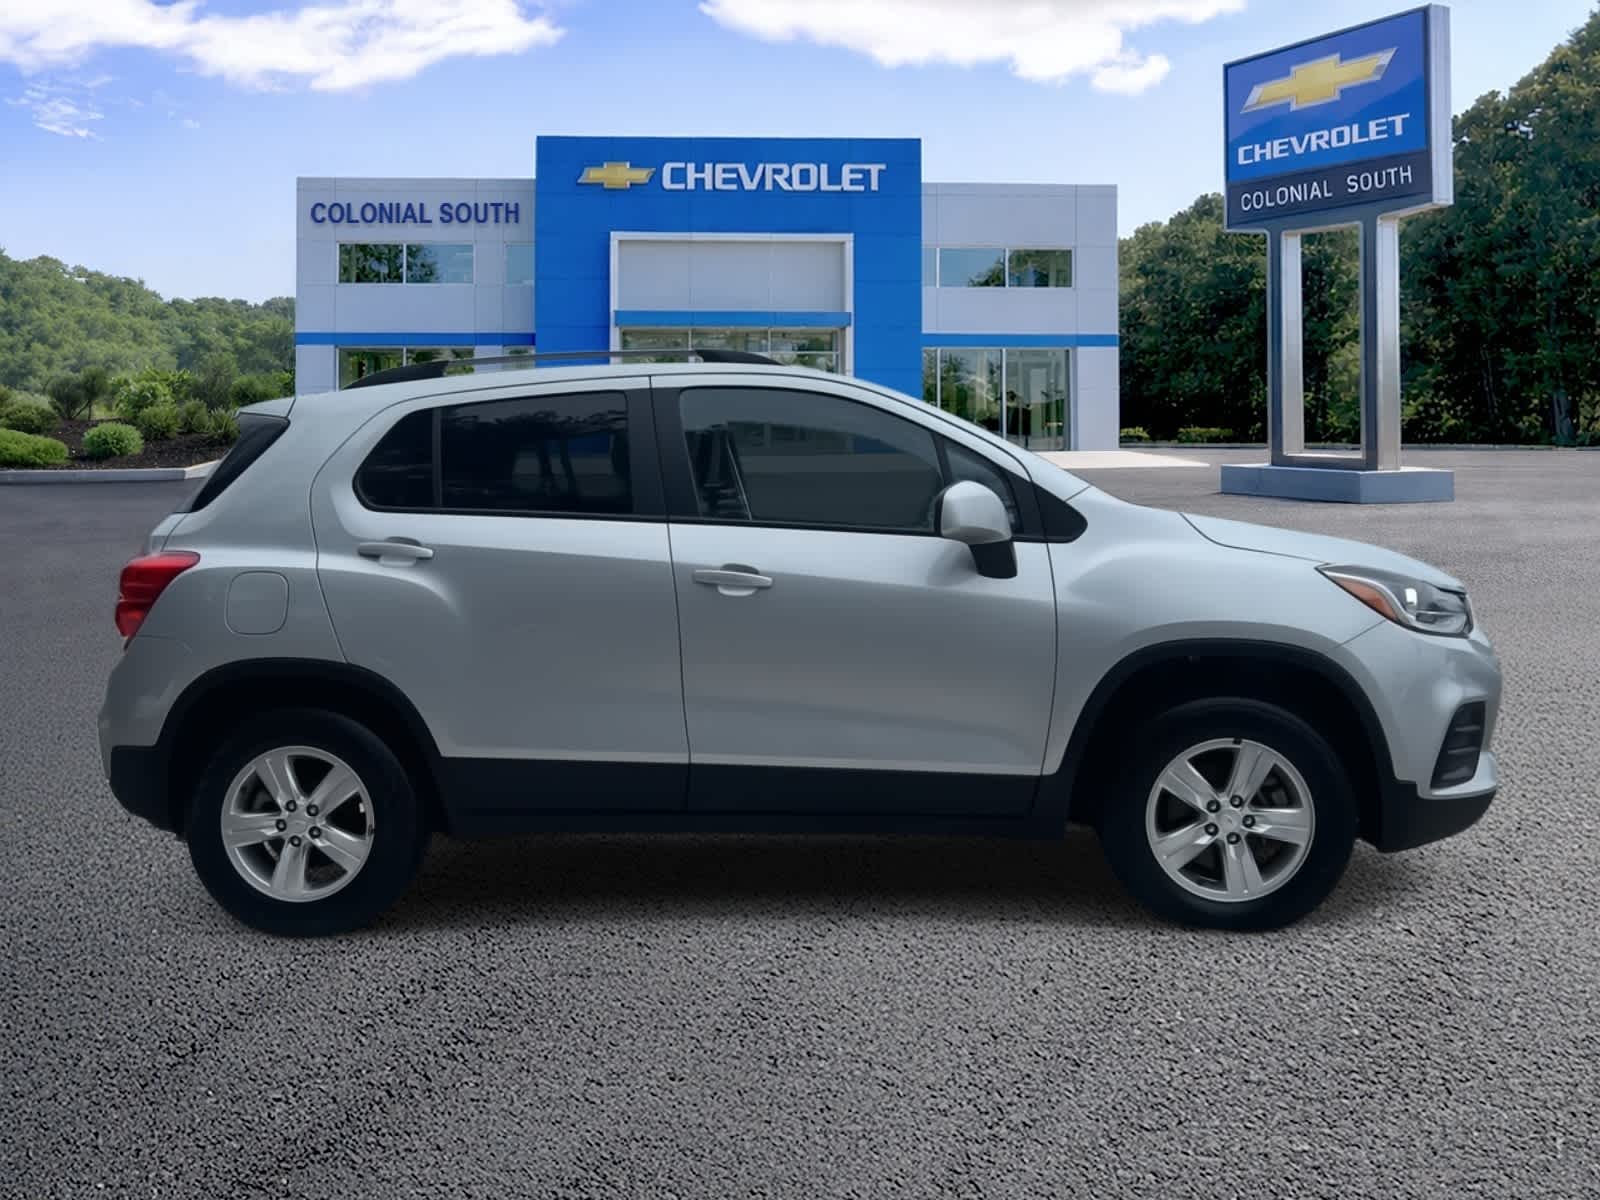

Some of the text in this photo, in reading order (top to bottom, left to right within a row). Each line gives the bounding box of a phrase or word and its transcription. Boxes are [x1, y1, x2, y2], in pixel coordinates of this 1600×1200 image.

[1237, 113, 1410, 165] CHEVROLET
[662, 161, 887, 191] CHEVROLET
[1241, 165, 1412, 211] COLONIAL SOUTH
[310, 202, 520, 225] COLONIAL SOUTH
